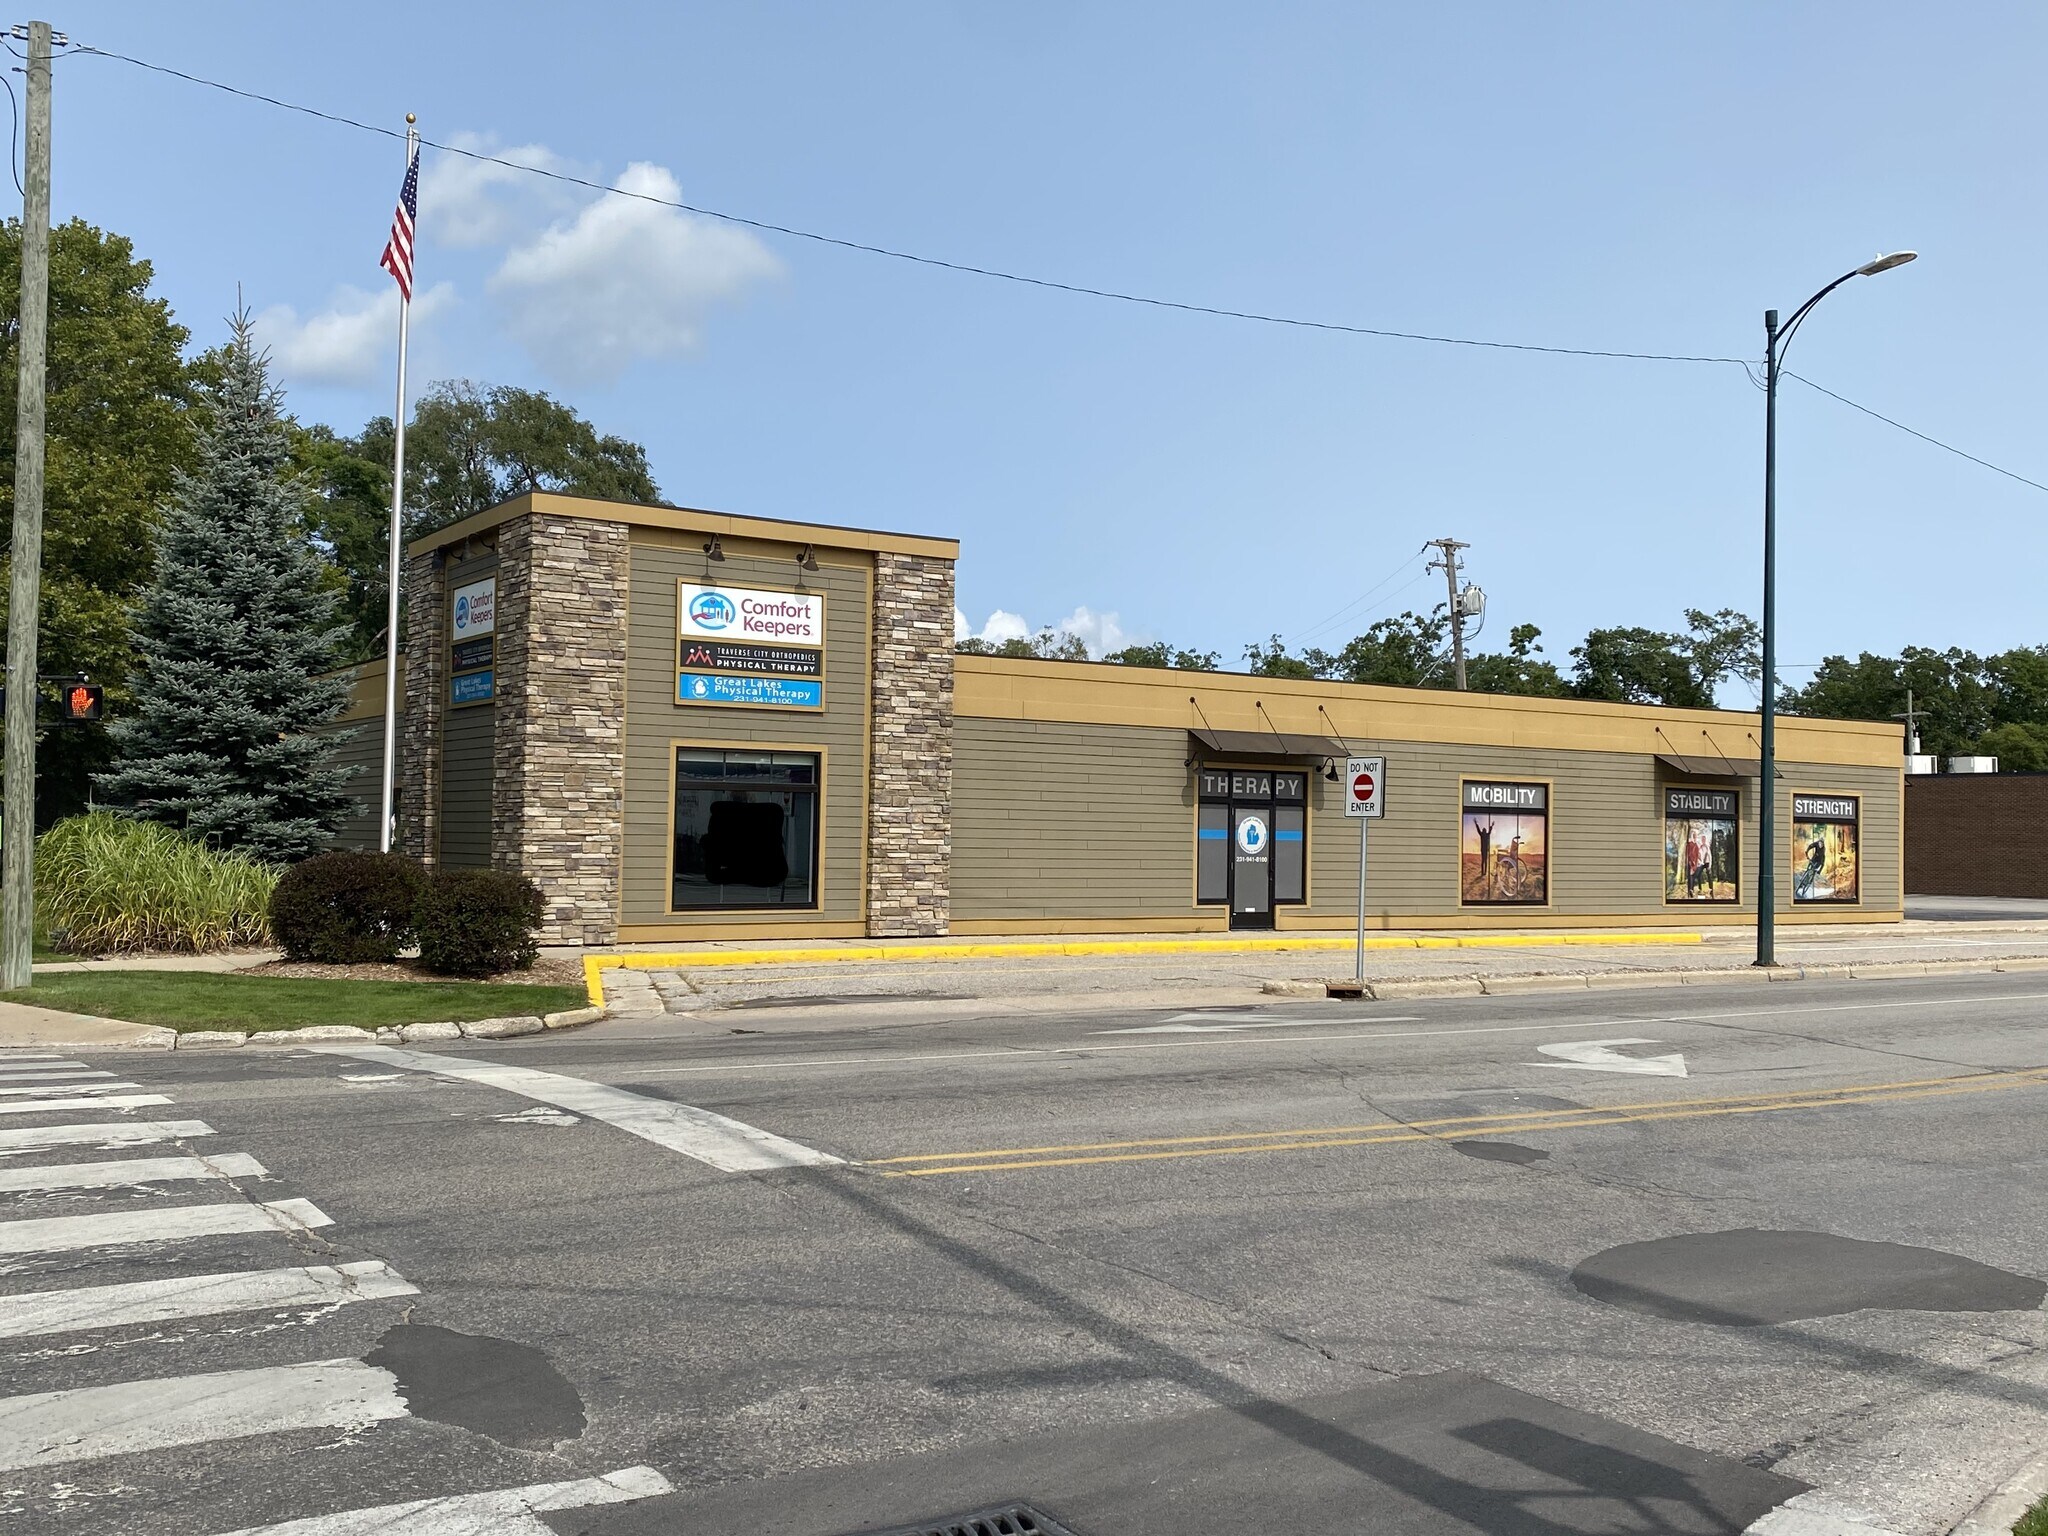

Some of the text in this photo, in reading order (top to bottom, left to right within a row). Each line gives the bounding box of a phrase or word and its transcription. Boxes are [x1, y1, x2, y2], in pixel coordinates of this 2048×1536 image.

[470, 591, 493, 609] Comfort
[741, 598, 811, 619] Comfort
[470, 609, 493, 625] Keepers
[743, 616, 811, 637] Keepers
[717, 647, 816, 661] TRAVERSE CITY ORTHOPEDICS
[716, 659, 815, 673] PHYSICAL THERAPY
[714, 676, 747, 687] Great
[750, 678, 782, 689] Lakes
[714, 685, 762, 696] Physical
[765, 687, 811, 701] Therapy
[733, 695, 793, 705] 231-941-8100
[1350, 762, 1379, 773] DO NOT
[1204, 776, 1299, 796] THERAPY
[1471, 787, 1536, 804] MOBILITY
[1670, 793, 1730, 810] STABILITY
[1351, 802, 1375, 812] ENTER
[1795, 799, 1853, 815] STRENGTH
